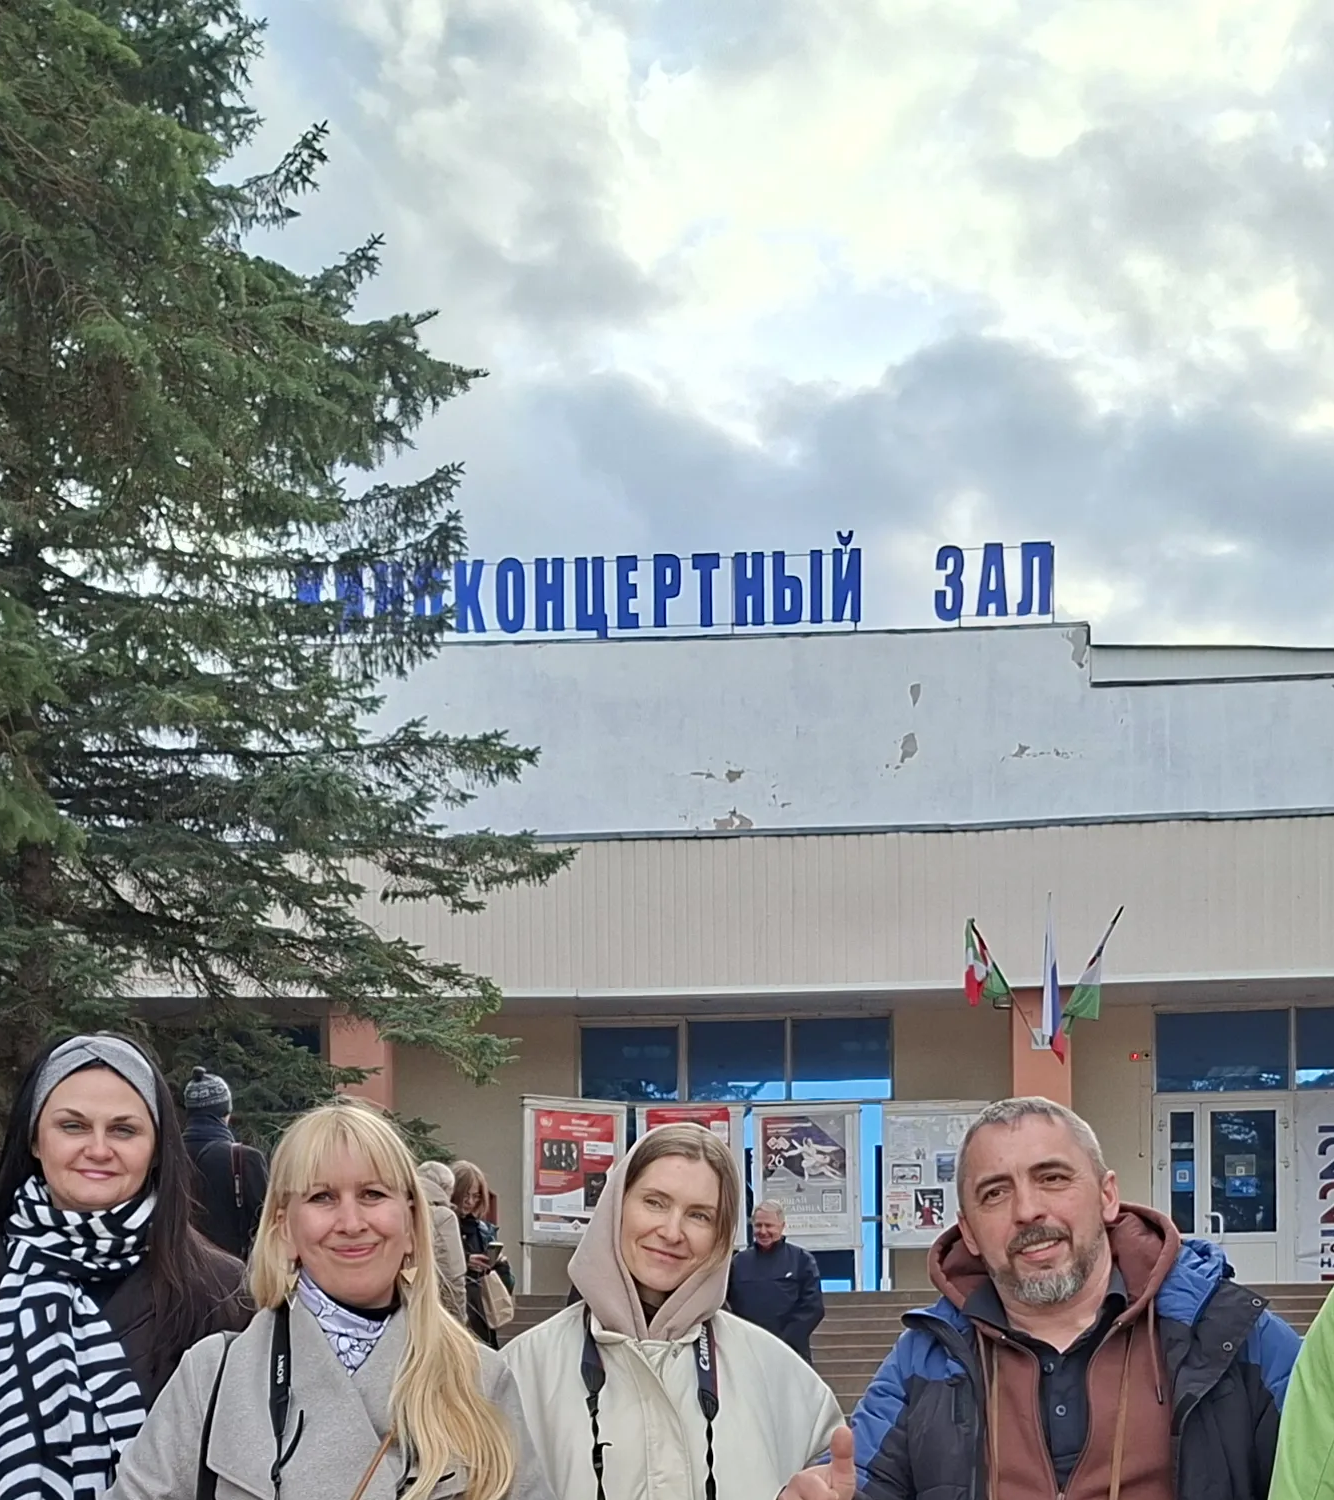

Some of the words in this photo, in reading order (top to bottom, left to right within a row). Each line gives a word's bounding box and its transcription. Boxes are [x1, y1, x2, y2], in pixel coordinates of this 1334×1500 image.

[296, 530, 861, 639] КОНЦЕРТНЫЙ
[934, 541, 1054, 622] ЗАЛ
[276, 1354, 285, 1385] SONY
